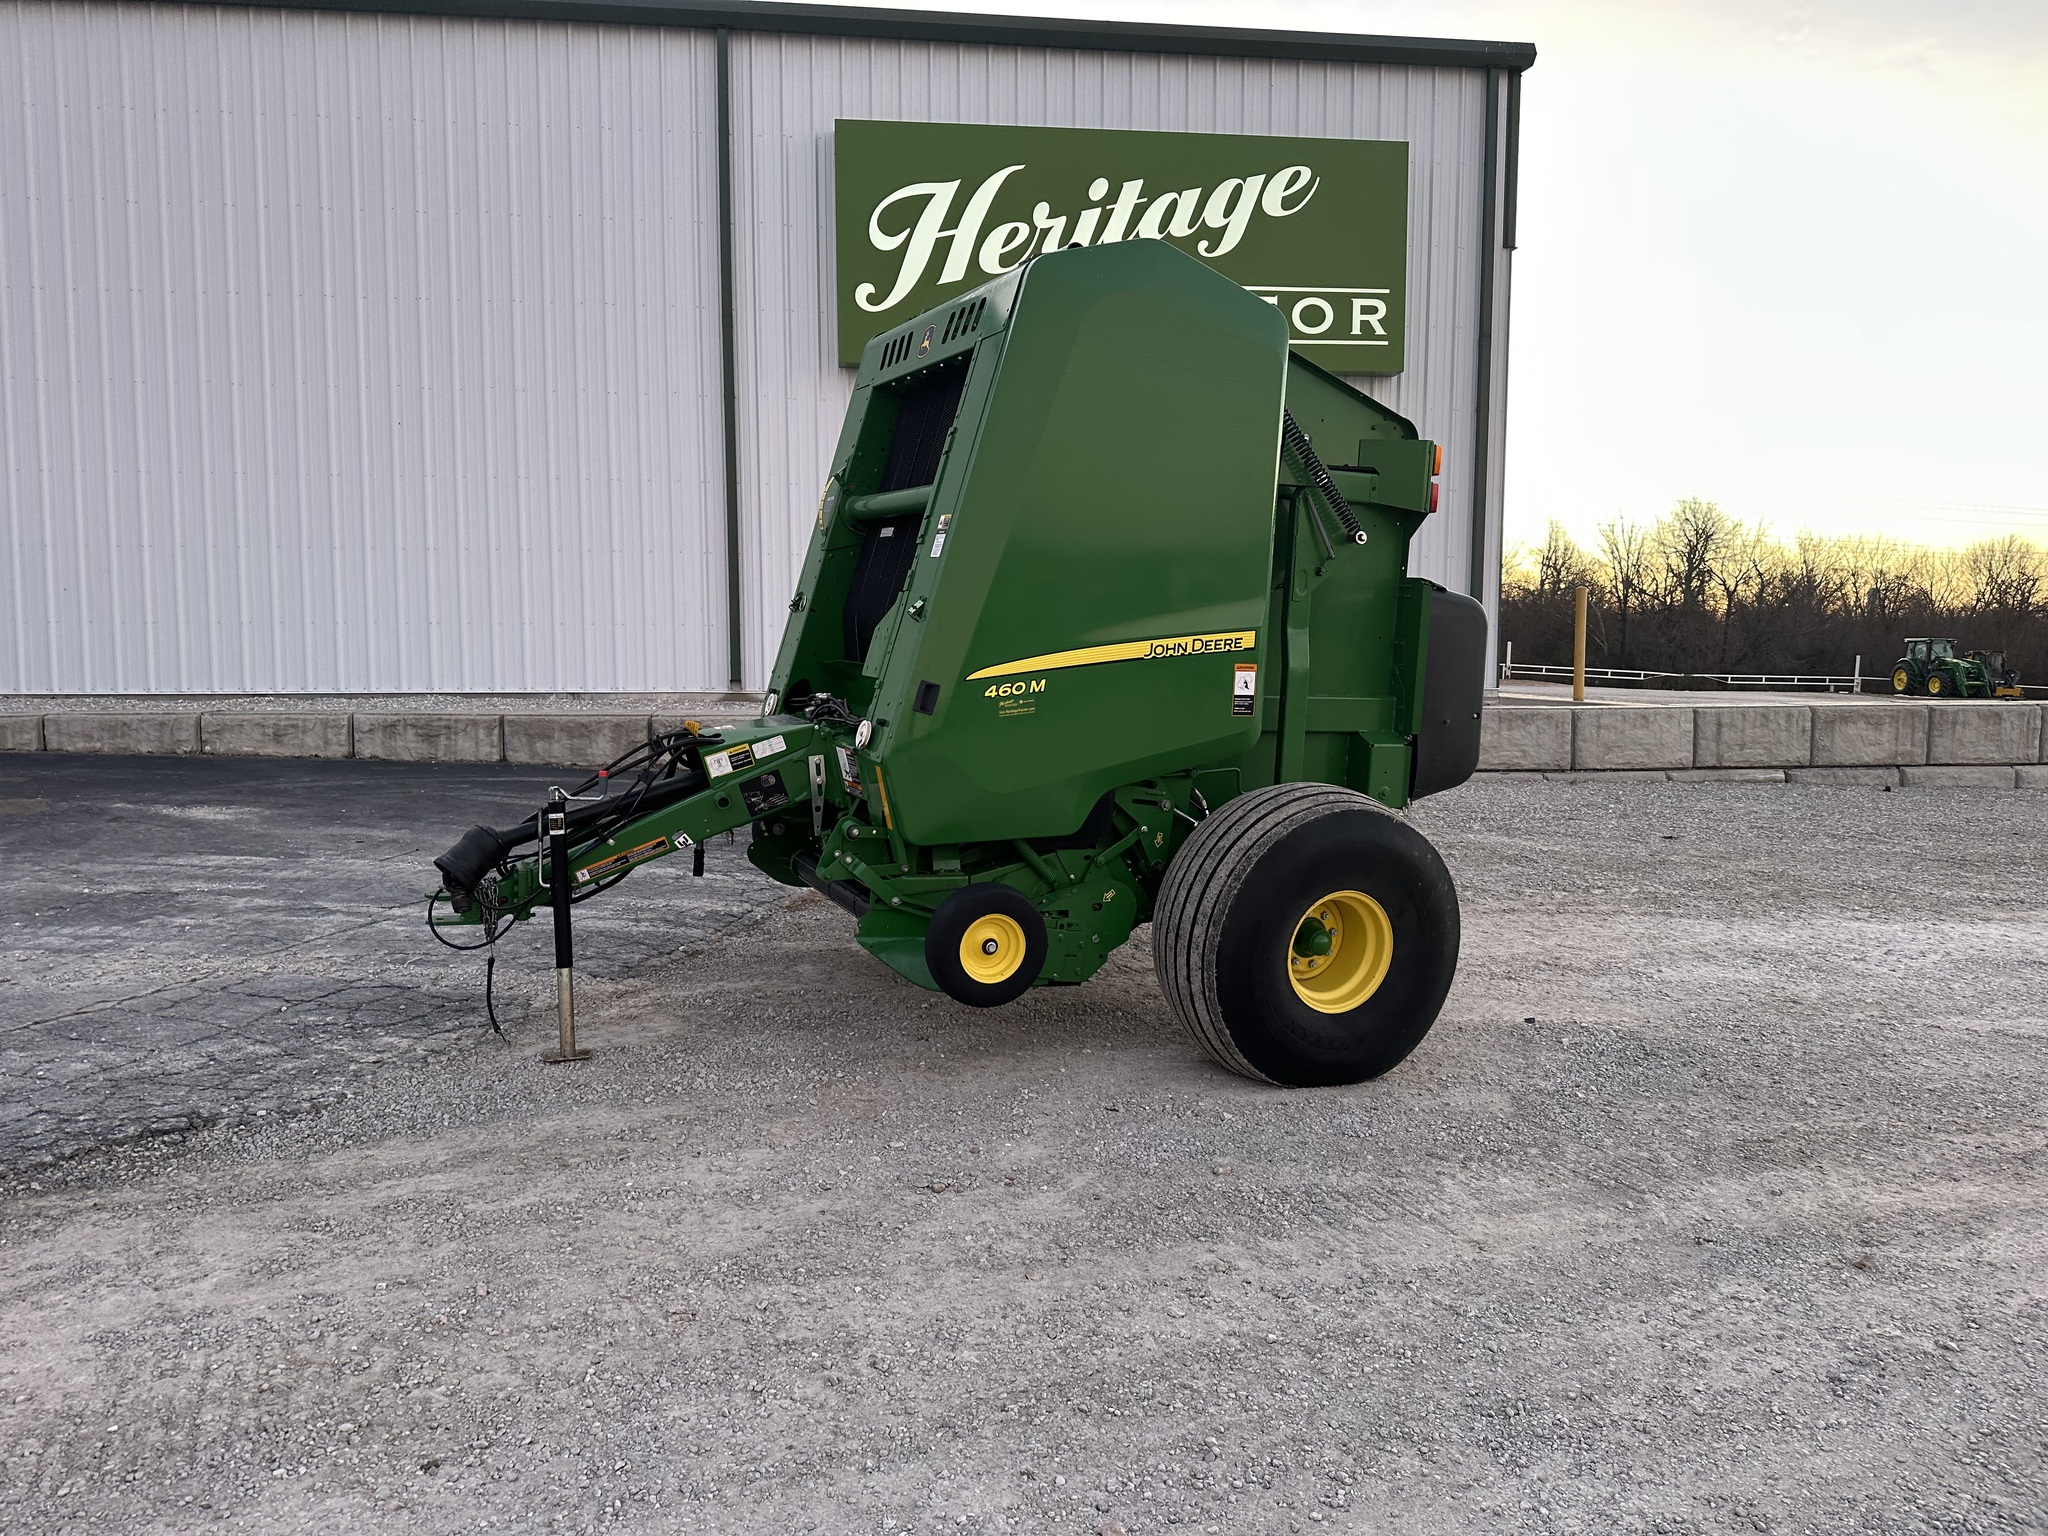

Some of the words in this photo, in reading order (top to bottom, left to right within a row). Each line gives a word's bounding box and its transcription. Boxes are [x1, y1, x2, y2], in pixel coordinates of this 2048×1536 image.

[854, 164, 1320, 312] Heritage
[1260, 294, 1388, 335] OR
[1143, 642, 1188, 658] JOHN
[1191, 637, 1243, 653] DEERE
[984, 682, 1026, 698] 460
[1029, 678, 1047, 693] M
